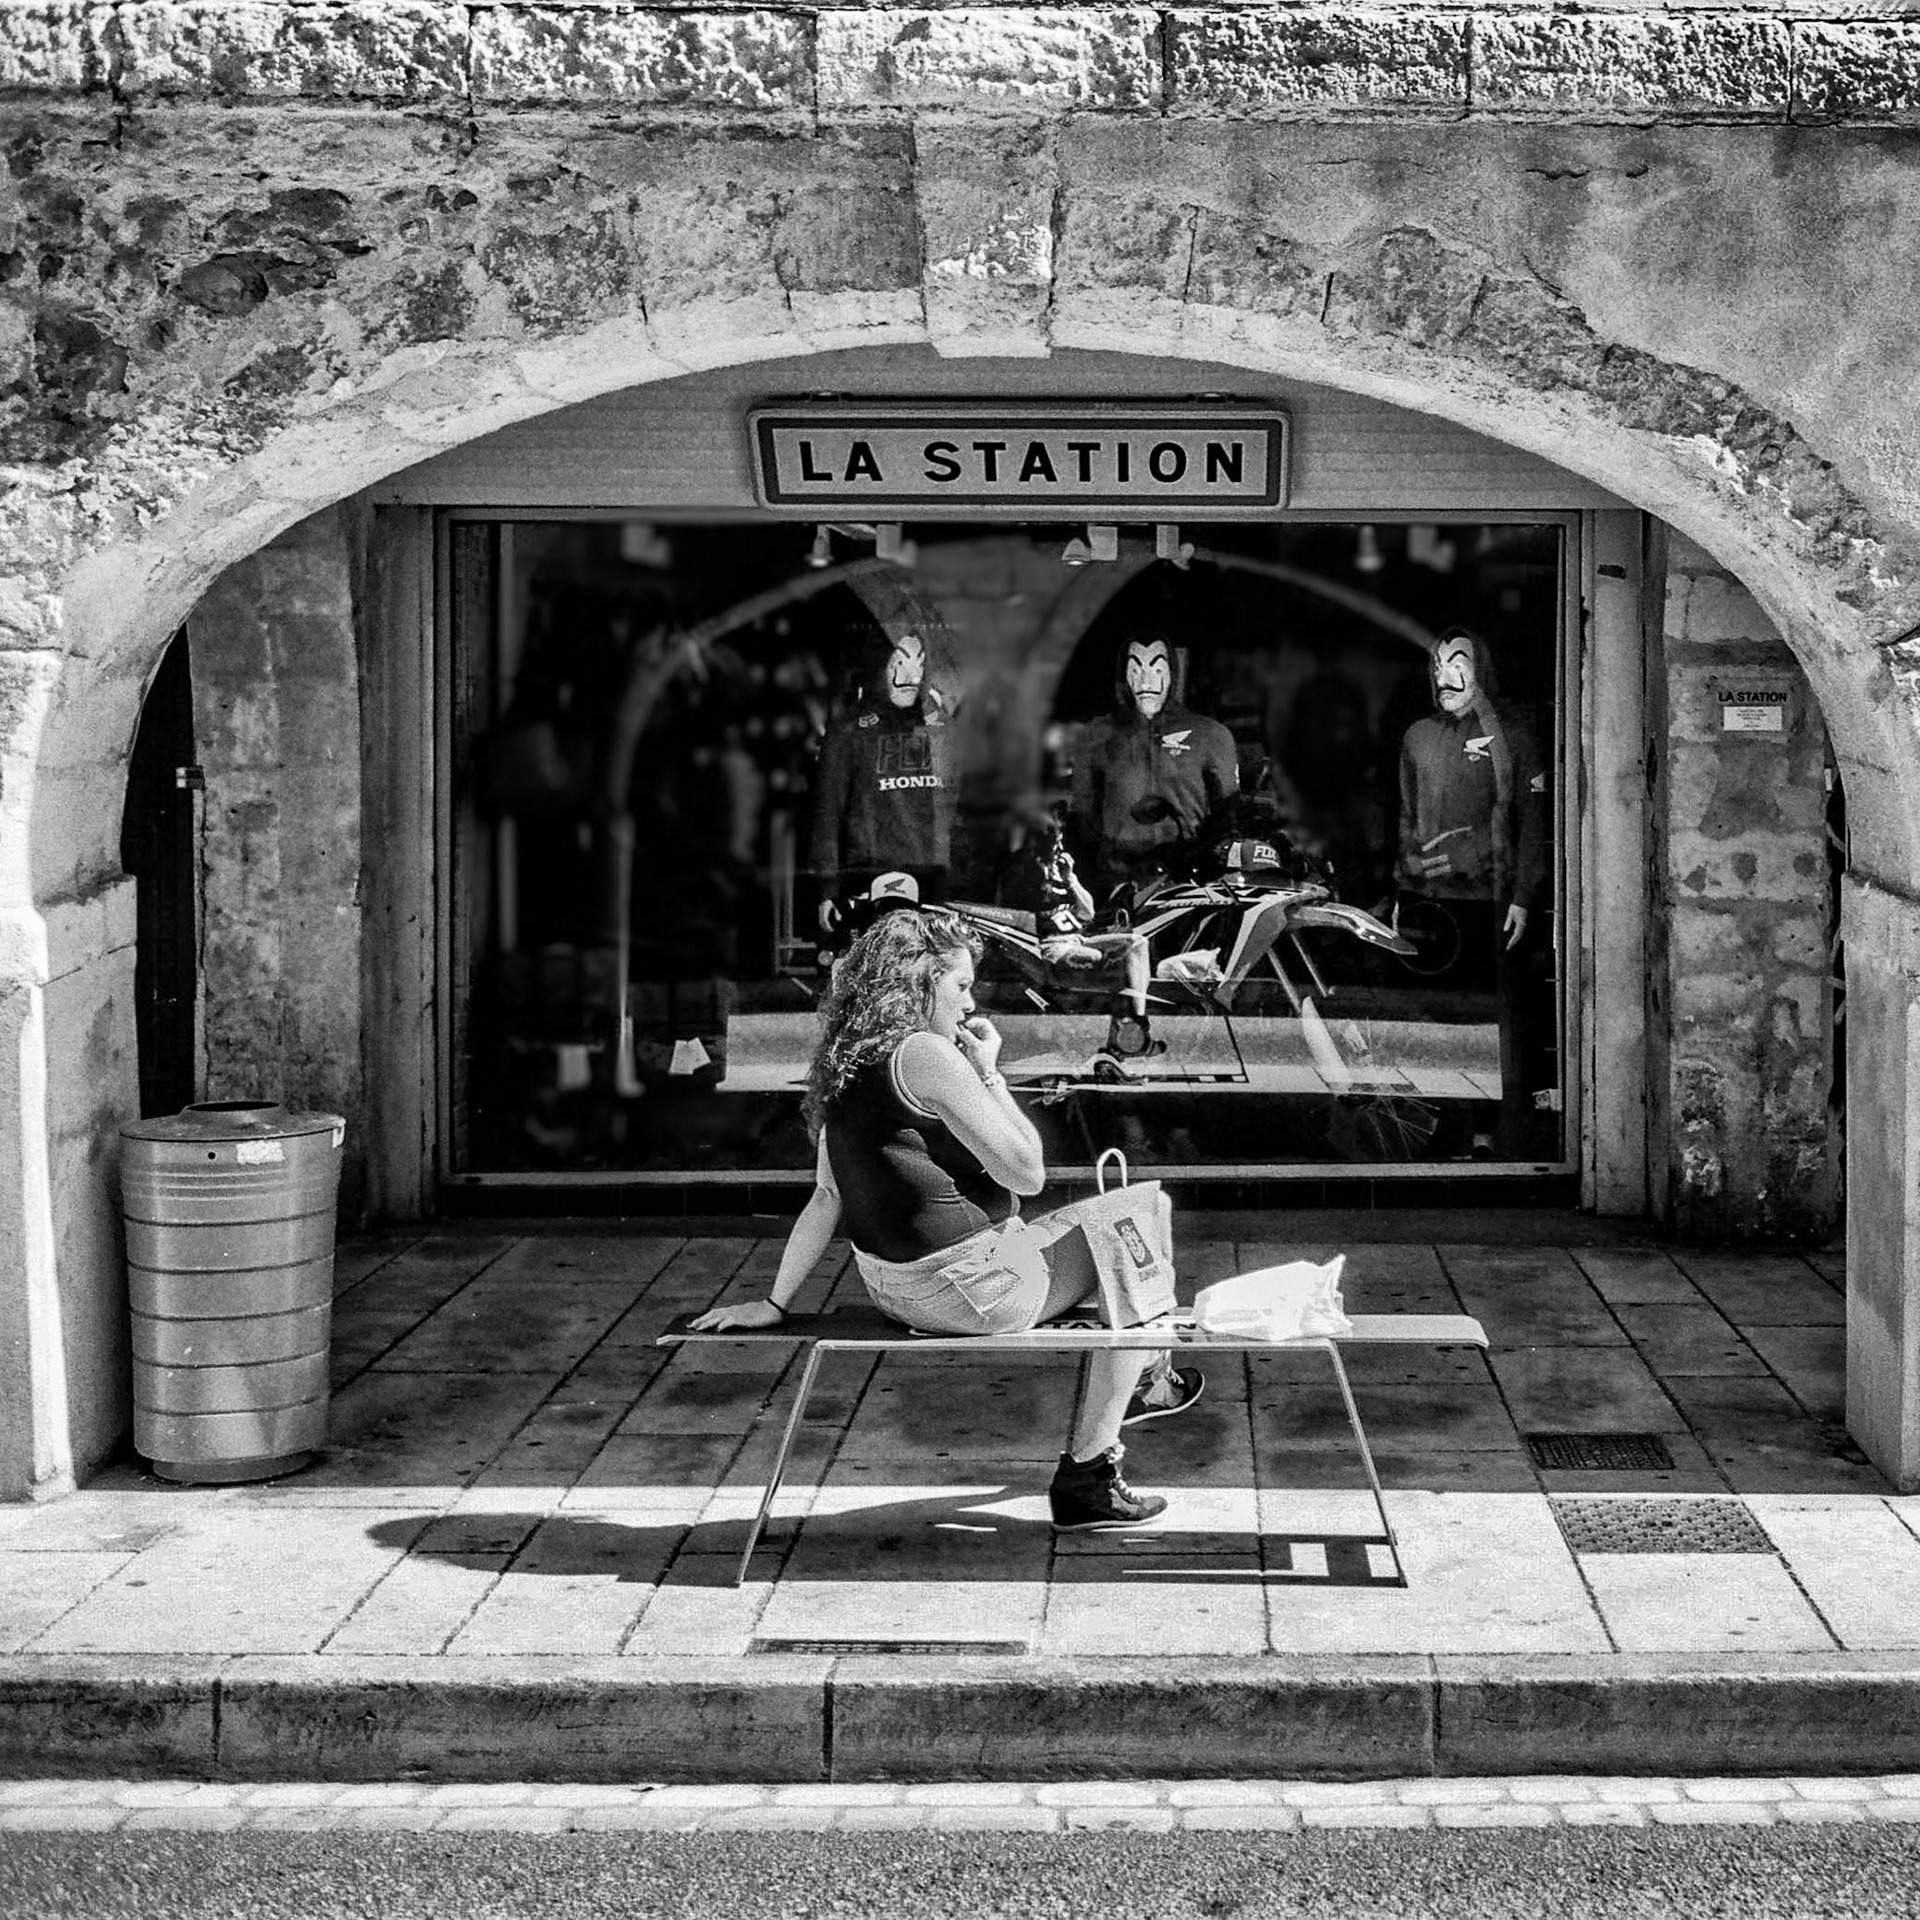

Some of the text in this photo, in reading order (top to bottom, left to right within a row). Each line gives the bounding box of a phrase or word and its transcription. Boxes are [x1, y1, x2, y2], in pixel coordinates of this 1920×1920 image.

[799, 440, 1245, 484] LA STATION
[1718, 691, 1787, 702] LA STATION
